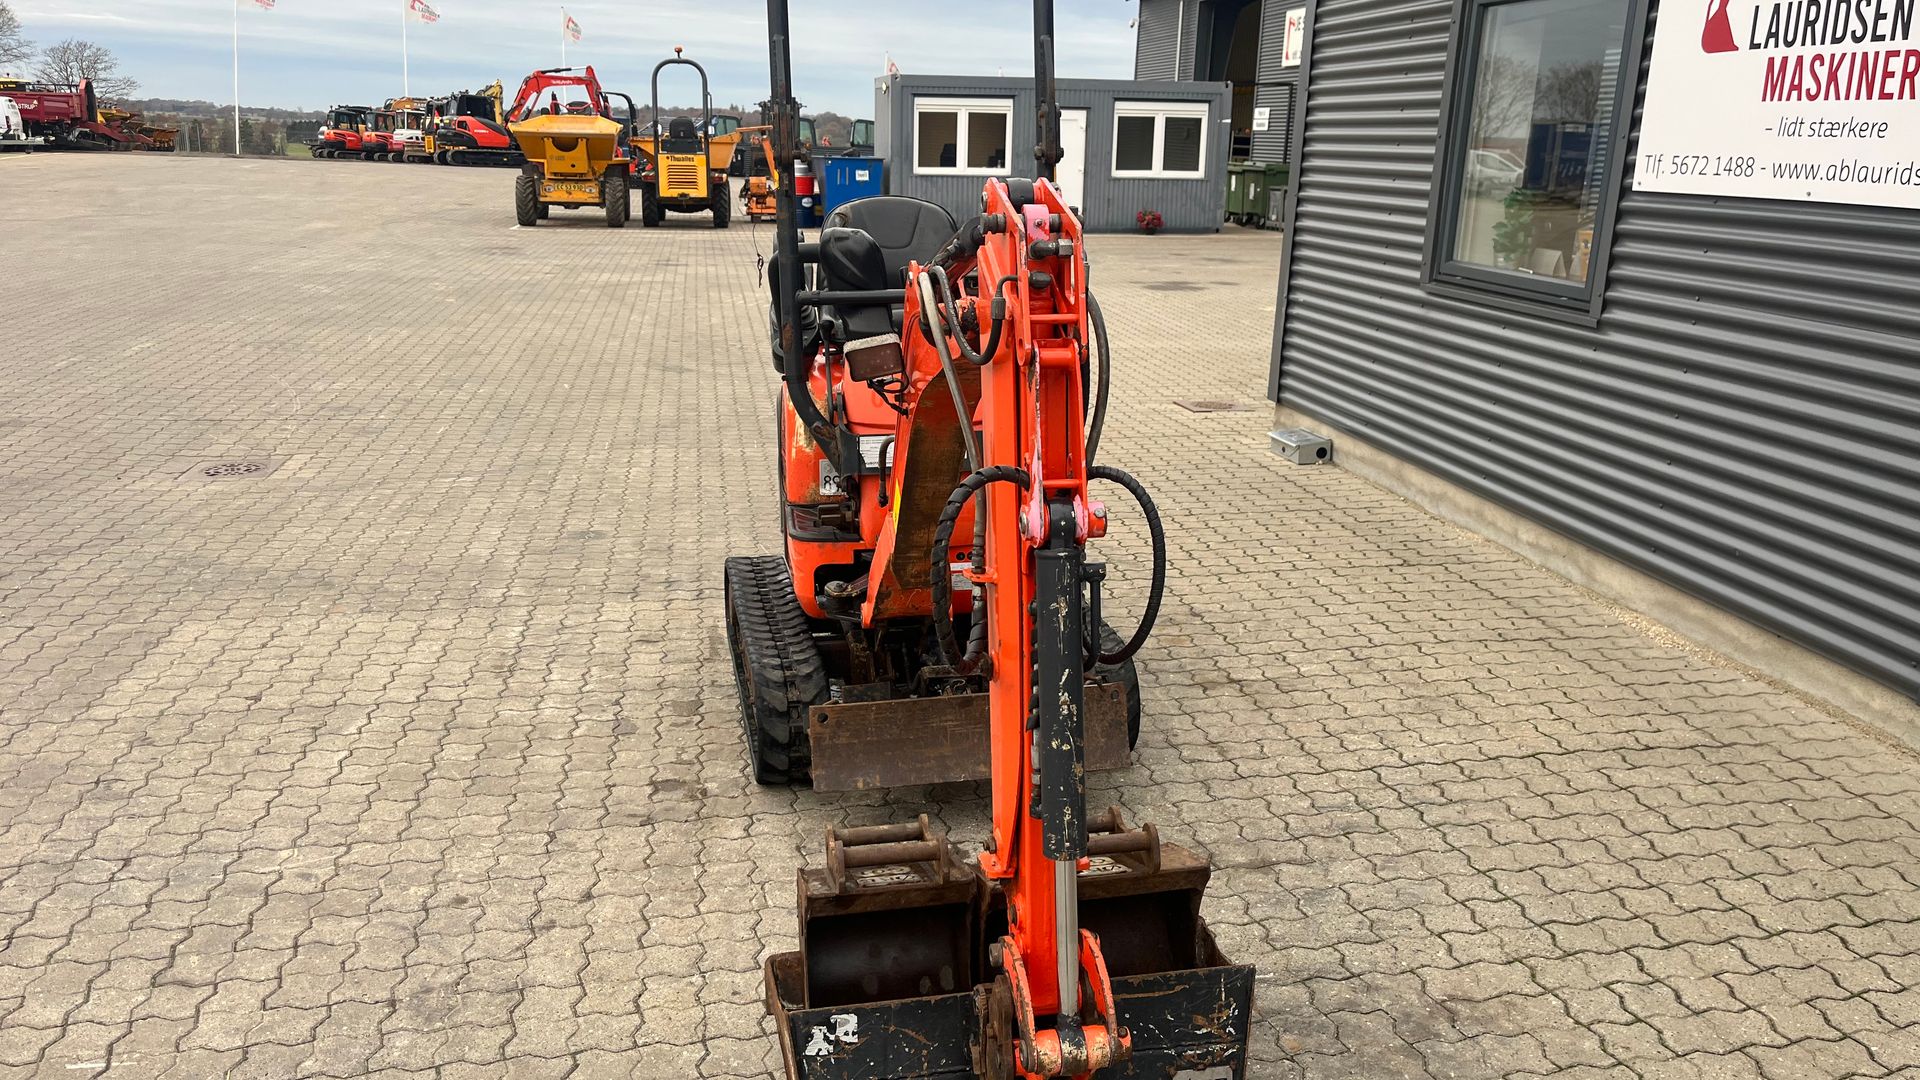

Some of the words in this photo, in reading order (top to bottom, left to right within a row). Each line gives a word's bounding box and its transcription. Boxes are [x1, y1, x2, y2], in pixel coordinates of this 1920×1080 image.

[1749, 0, 1914, 50] LAURIDSEN
[1762, 49, 1920, 102] MASKINER
[1777, 116, 1805, 137] lidt
[1808, 116, 1889, 139] stærkere
[1645, 153, 1665, 179] Tlf.
[1670, 155, 1709, 176] 5672
[1713, 156, 1755, 177] 1488
[1772, 158, 1920, 186] www.ablaurids
